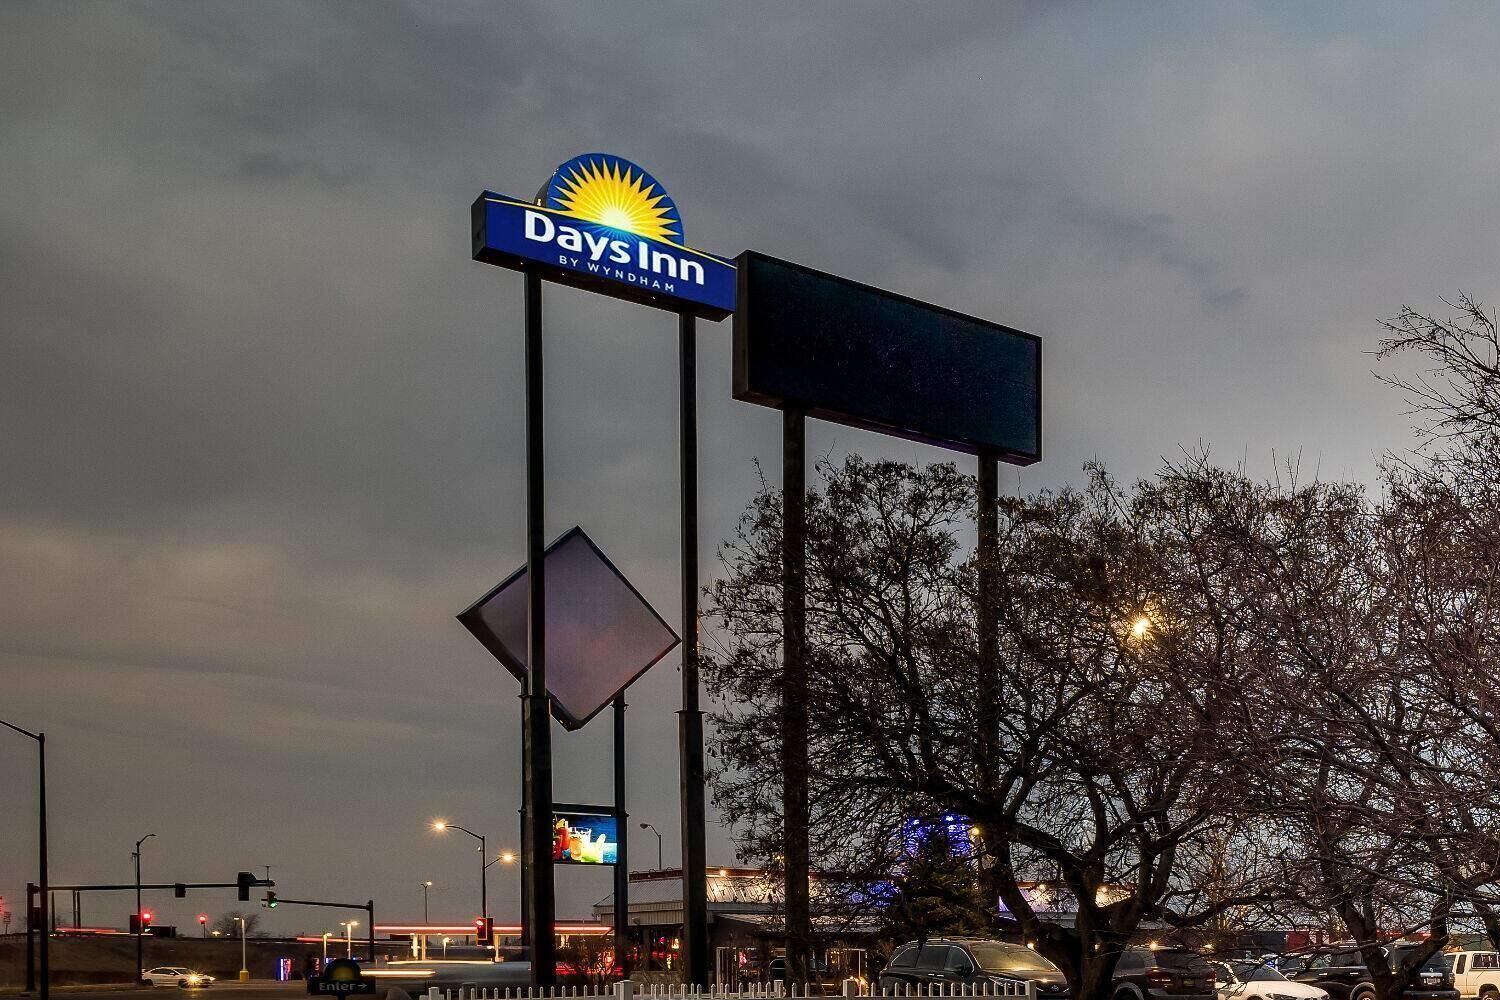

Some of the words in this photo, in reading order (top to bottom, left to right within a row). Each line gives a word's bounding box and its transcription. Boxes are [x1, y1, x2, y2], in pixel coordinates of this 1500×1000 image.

[525, 210, 631, 266] Days
[639, 241, 705, 285] Inn
[559, 255, 578, 267] BY
[587, 262, 675, 293] WYNDHAM
[319, 982, 356, 991] Enter
